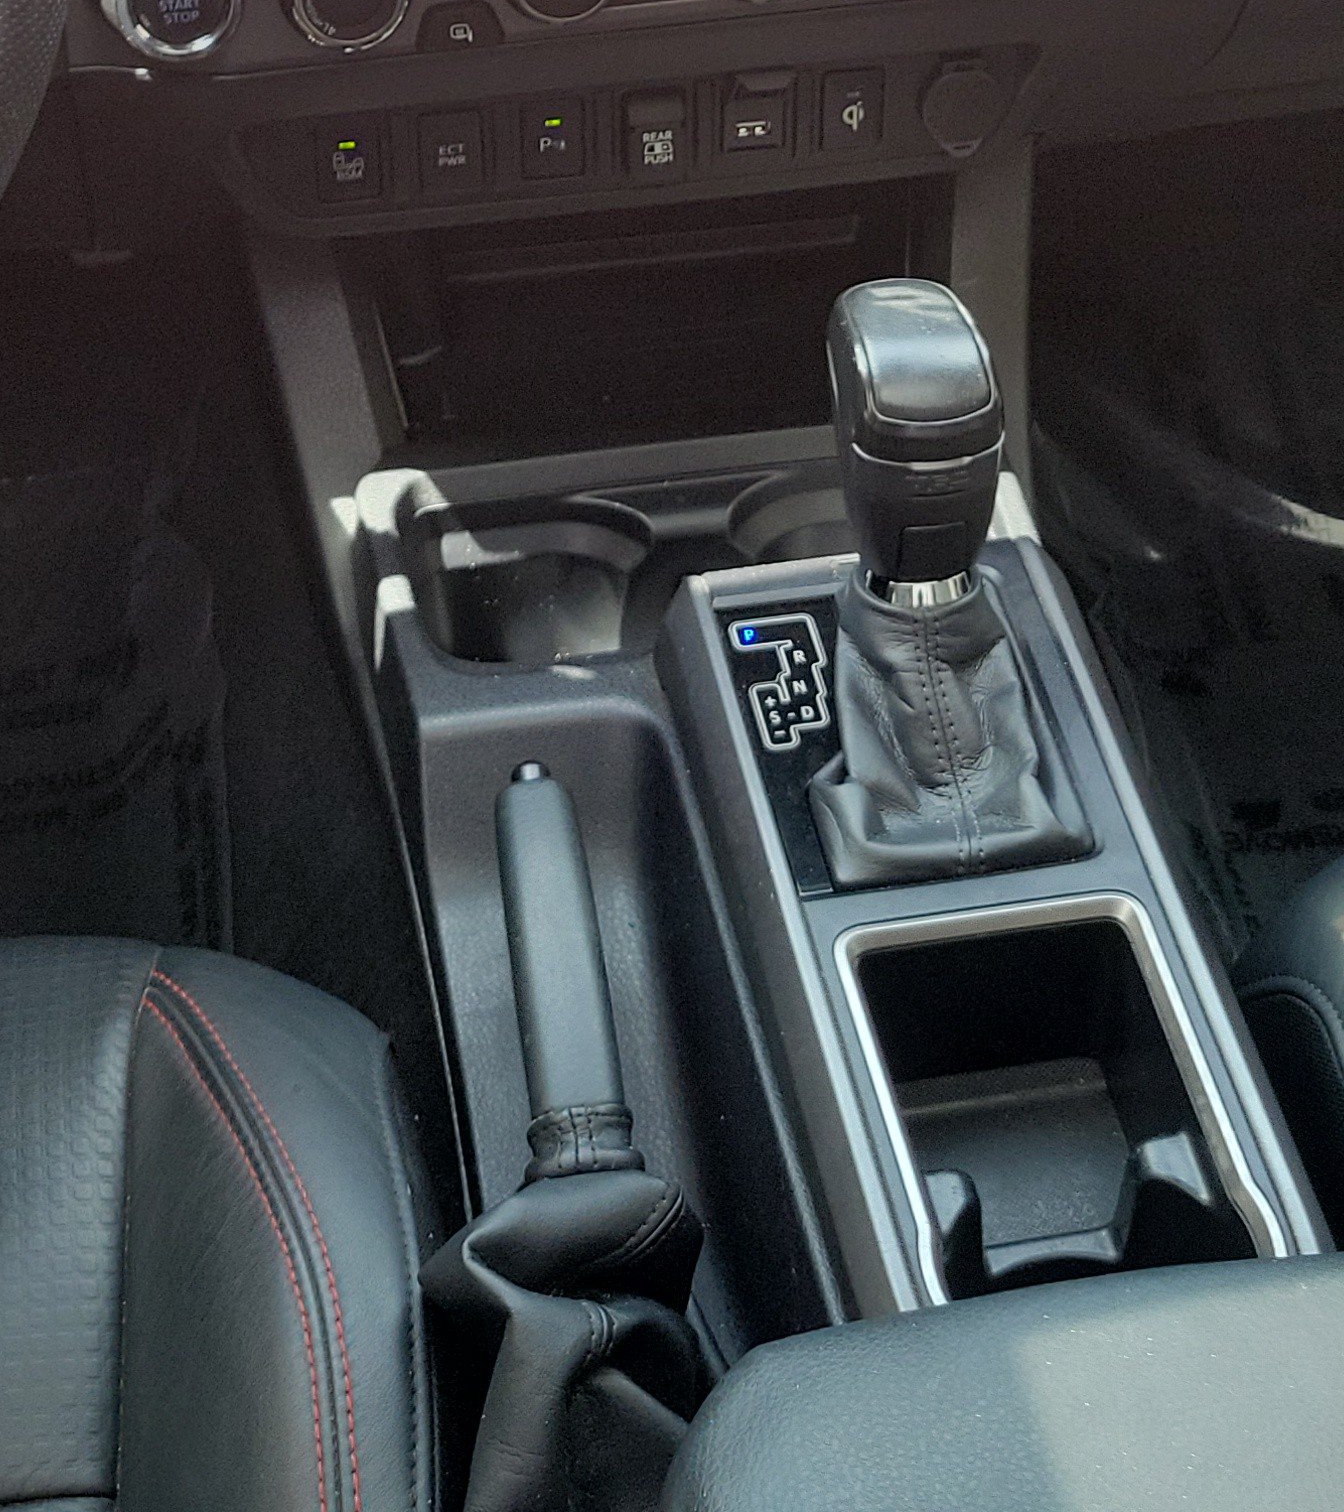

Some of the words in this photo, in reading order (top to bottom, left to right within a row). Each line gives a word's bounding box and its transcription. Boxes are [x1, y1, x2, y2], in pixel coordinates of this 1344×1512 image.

[163, 10, 199, 25] STOP
[642, 129, 673, 143] REAR
[439, 143, 463, 155] ECT
[439, 155, 466, 167] PWR
[643, 153, 674, 165] PUSH
[744, 628, 755, 642] P
[792, 649, 807, 666] R
[792, 679, 808, 696] N
[768, 710, 782, 726] S
[799, 705, 815, 722] D
